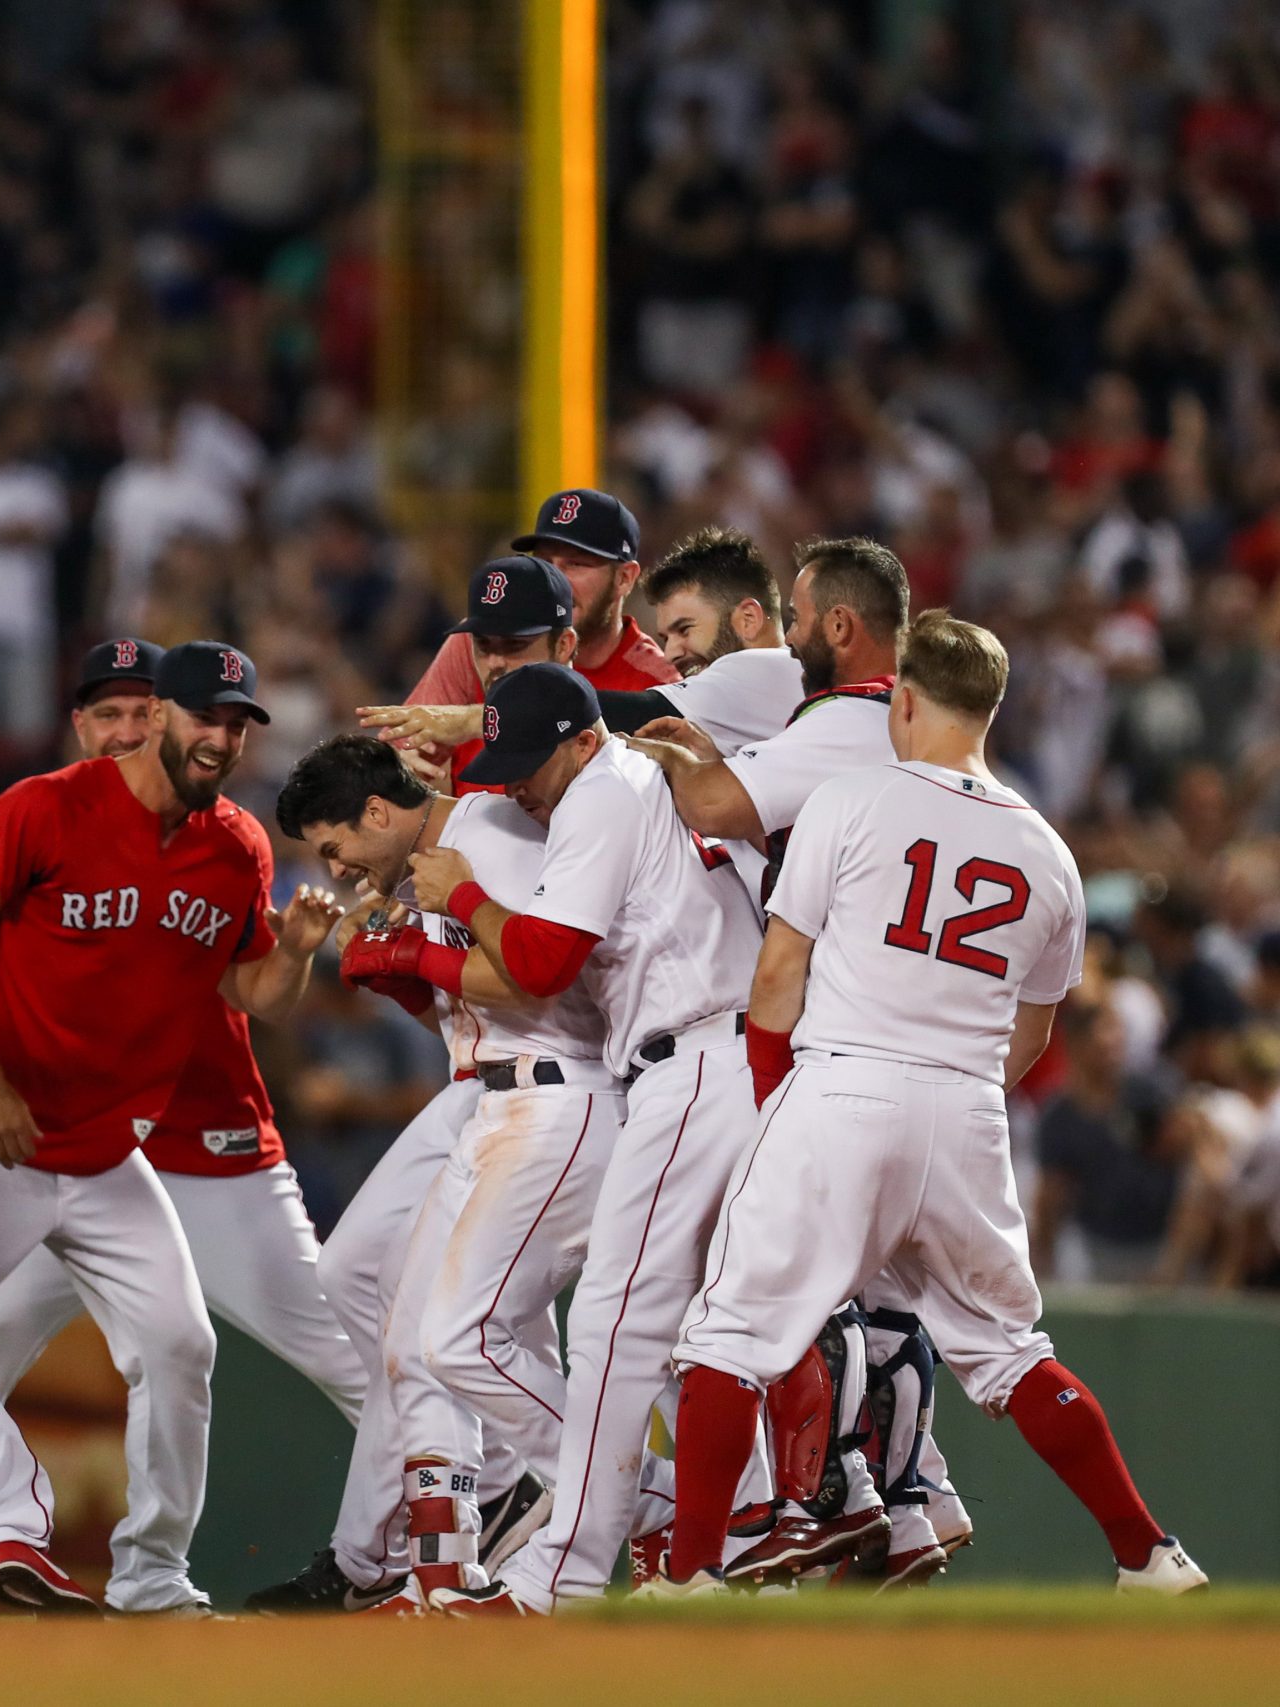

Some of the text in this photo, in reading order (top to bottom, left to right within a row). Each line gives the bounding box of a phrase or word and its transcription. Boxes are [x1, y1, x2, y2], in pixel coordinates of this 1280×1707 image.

[553, 494, 581, 524] B
[481, 571, 508, 604] B
[112, 640, 138, 668] B
[219, 652, 244, 682] B
[61, 886, 232, 947] RED SOX
[884, 838, 1031, 980] 12
